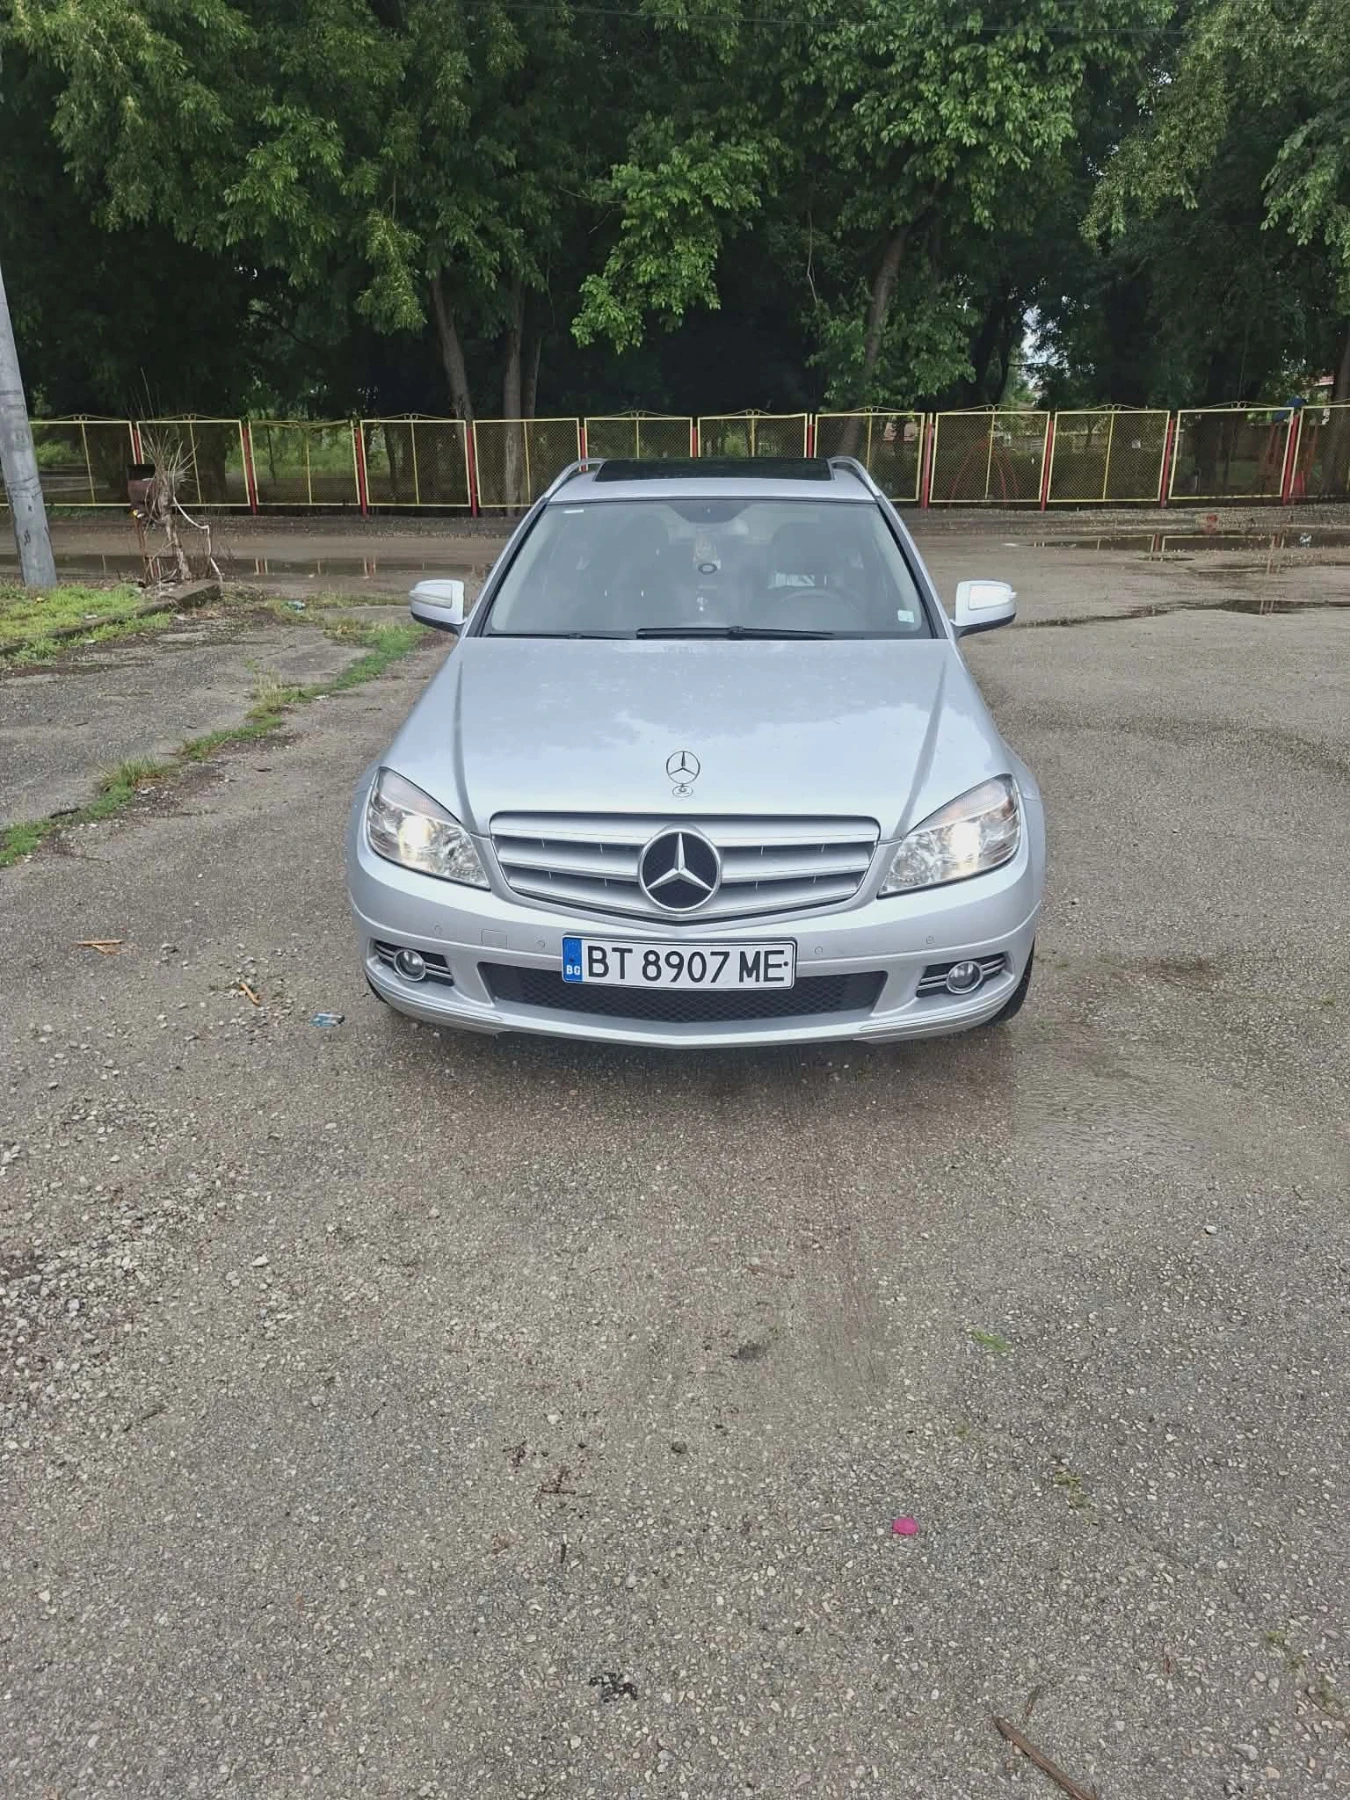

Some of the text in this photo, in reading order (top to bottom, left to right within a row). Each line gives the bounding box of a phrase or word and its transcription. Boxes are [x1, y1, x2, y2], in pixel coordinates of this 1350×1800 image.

[566, 964, 581, 975] BG
[587, 946, 785, 983] BT 8907 ME
